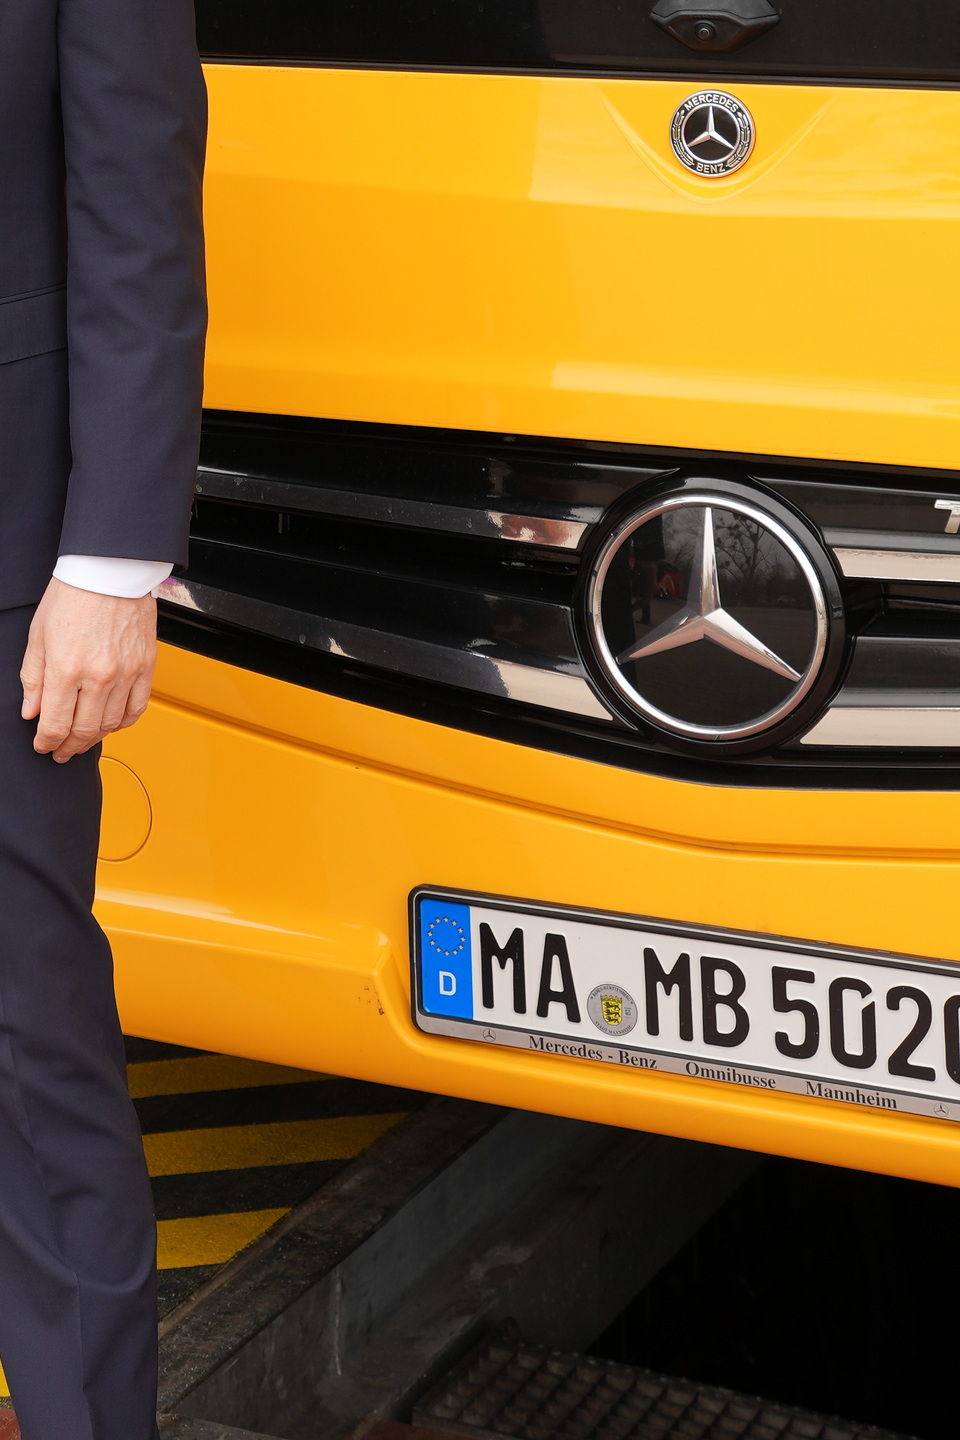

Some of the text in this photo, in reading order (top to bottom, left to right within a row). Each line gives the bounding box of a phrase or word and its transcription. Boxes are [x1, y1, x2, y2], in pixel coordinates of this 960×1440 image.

[684, 93, 739, 112] MERCEDES
[696, 162, 726, 174] BENZ
[439, 970, 457, 996] D
[479, 922, 581, 1023] MA
[643, 948, 750, 1048] MB
[529, 1035, 603, 1060] Mercedes
[618, 1050, 658, 1069] Benz
[685, 1062, 777, 1089] Omnibusse
[806, 1081, 898, 1109] Mannheim
